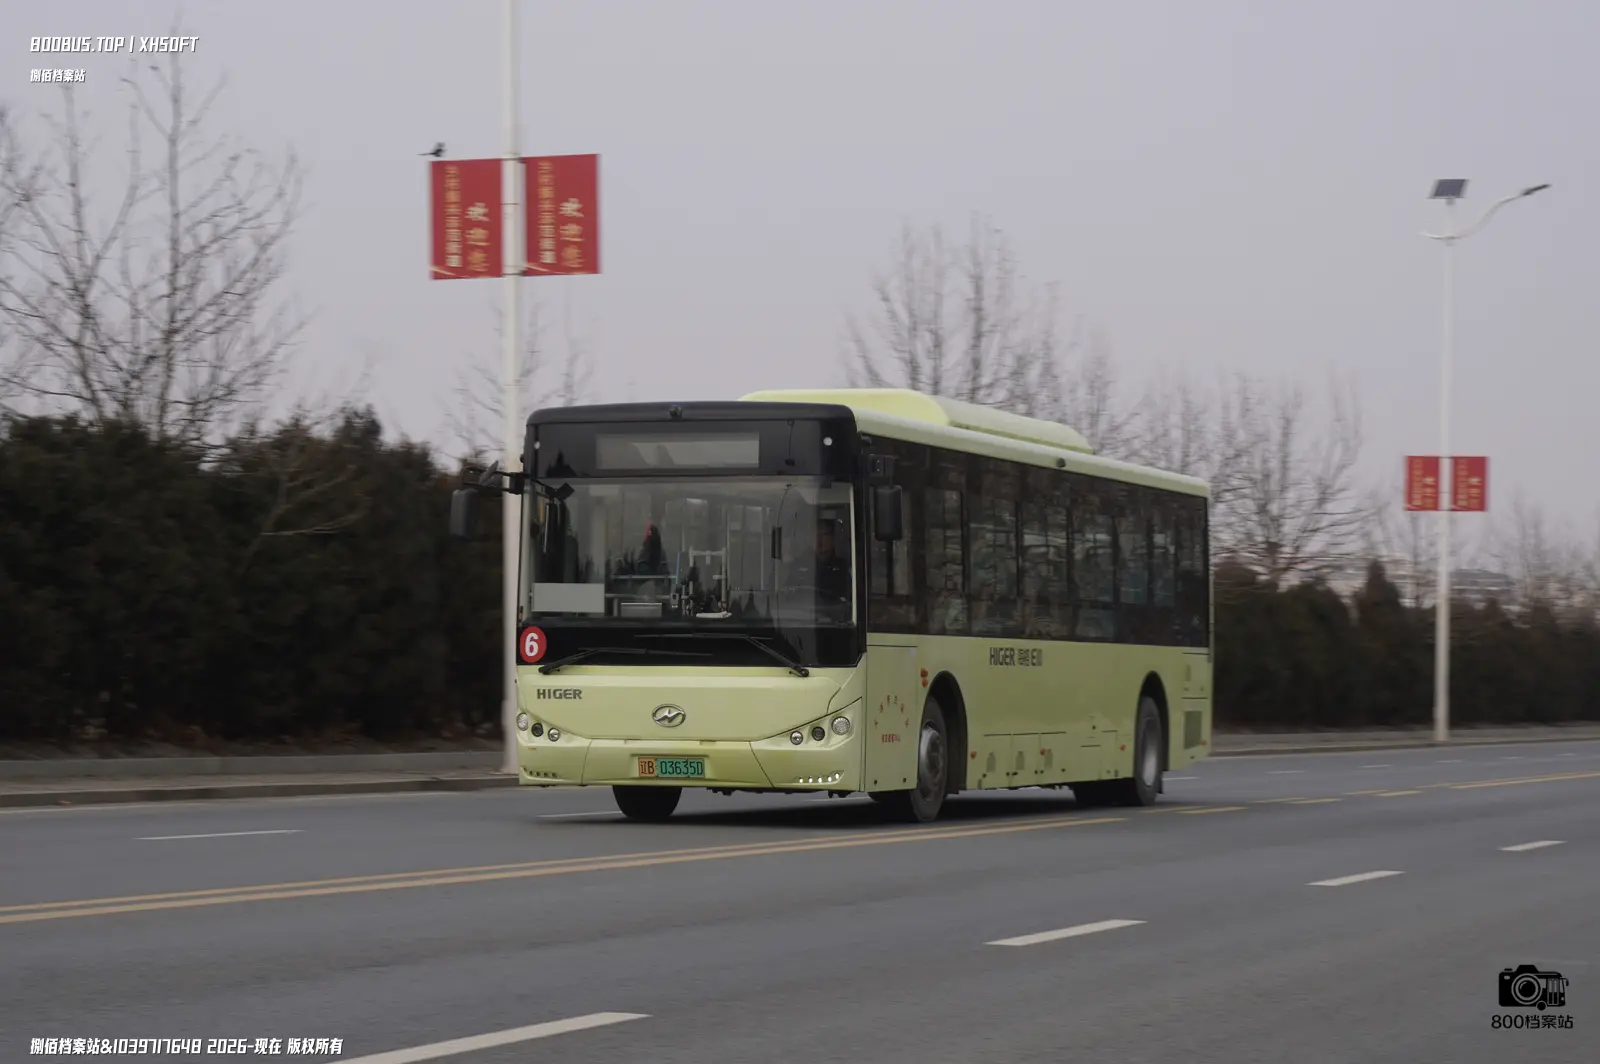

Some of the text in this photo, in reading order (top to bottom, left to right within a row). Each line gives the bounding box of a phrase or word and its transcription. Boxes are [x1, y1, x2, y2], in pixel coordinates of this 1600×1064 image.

[524, 632, 539, 657] 6
[989, 647, 1016, 666] HIGER
[537, 688, 583, 700] HIGER
[660, 760, 704, 776] 03635D
